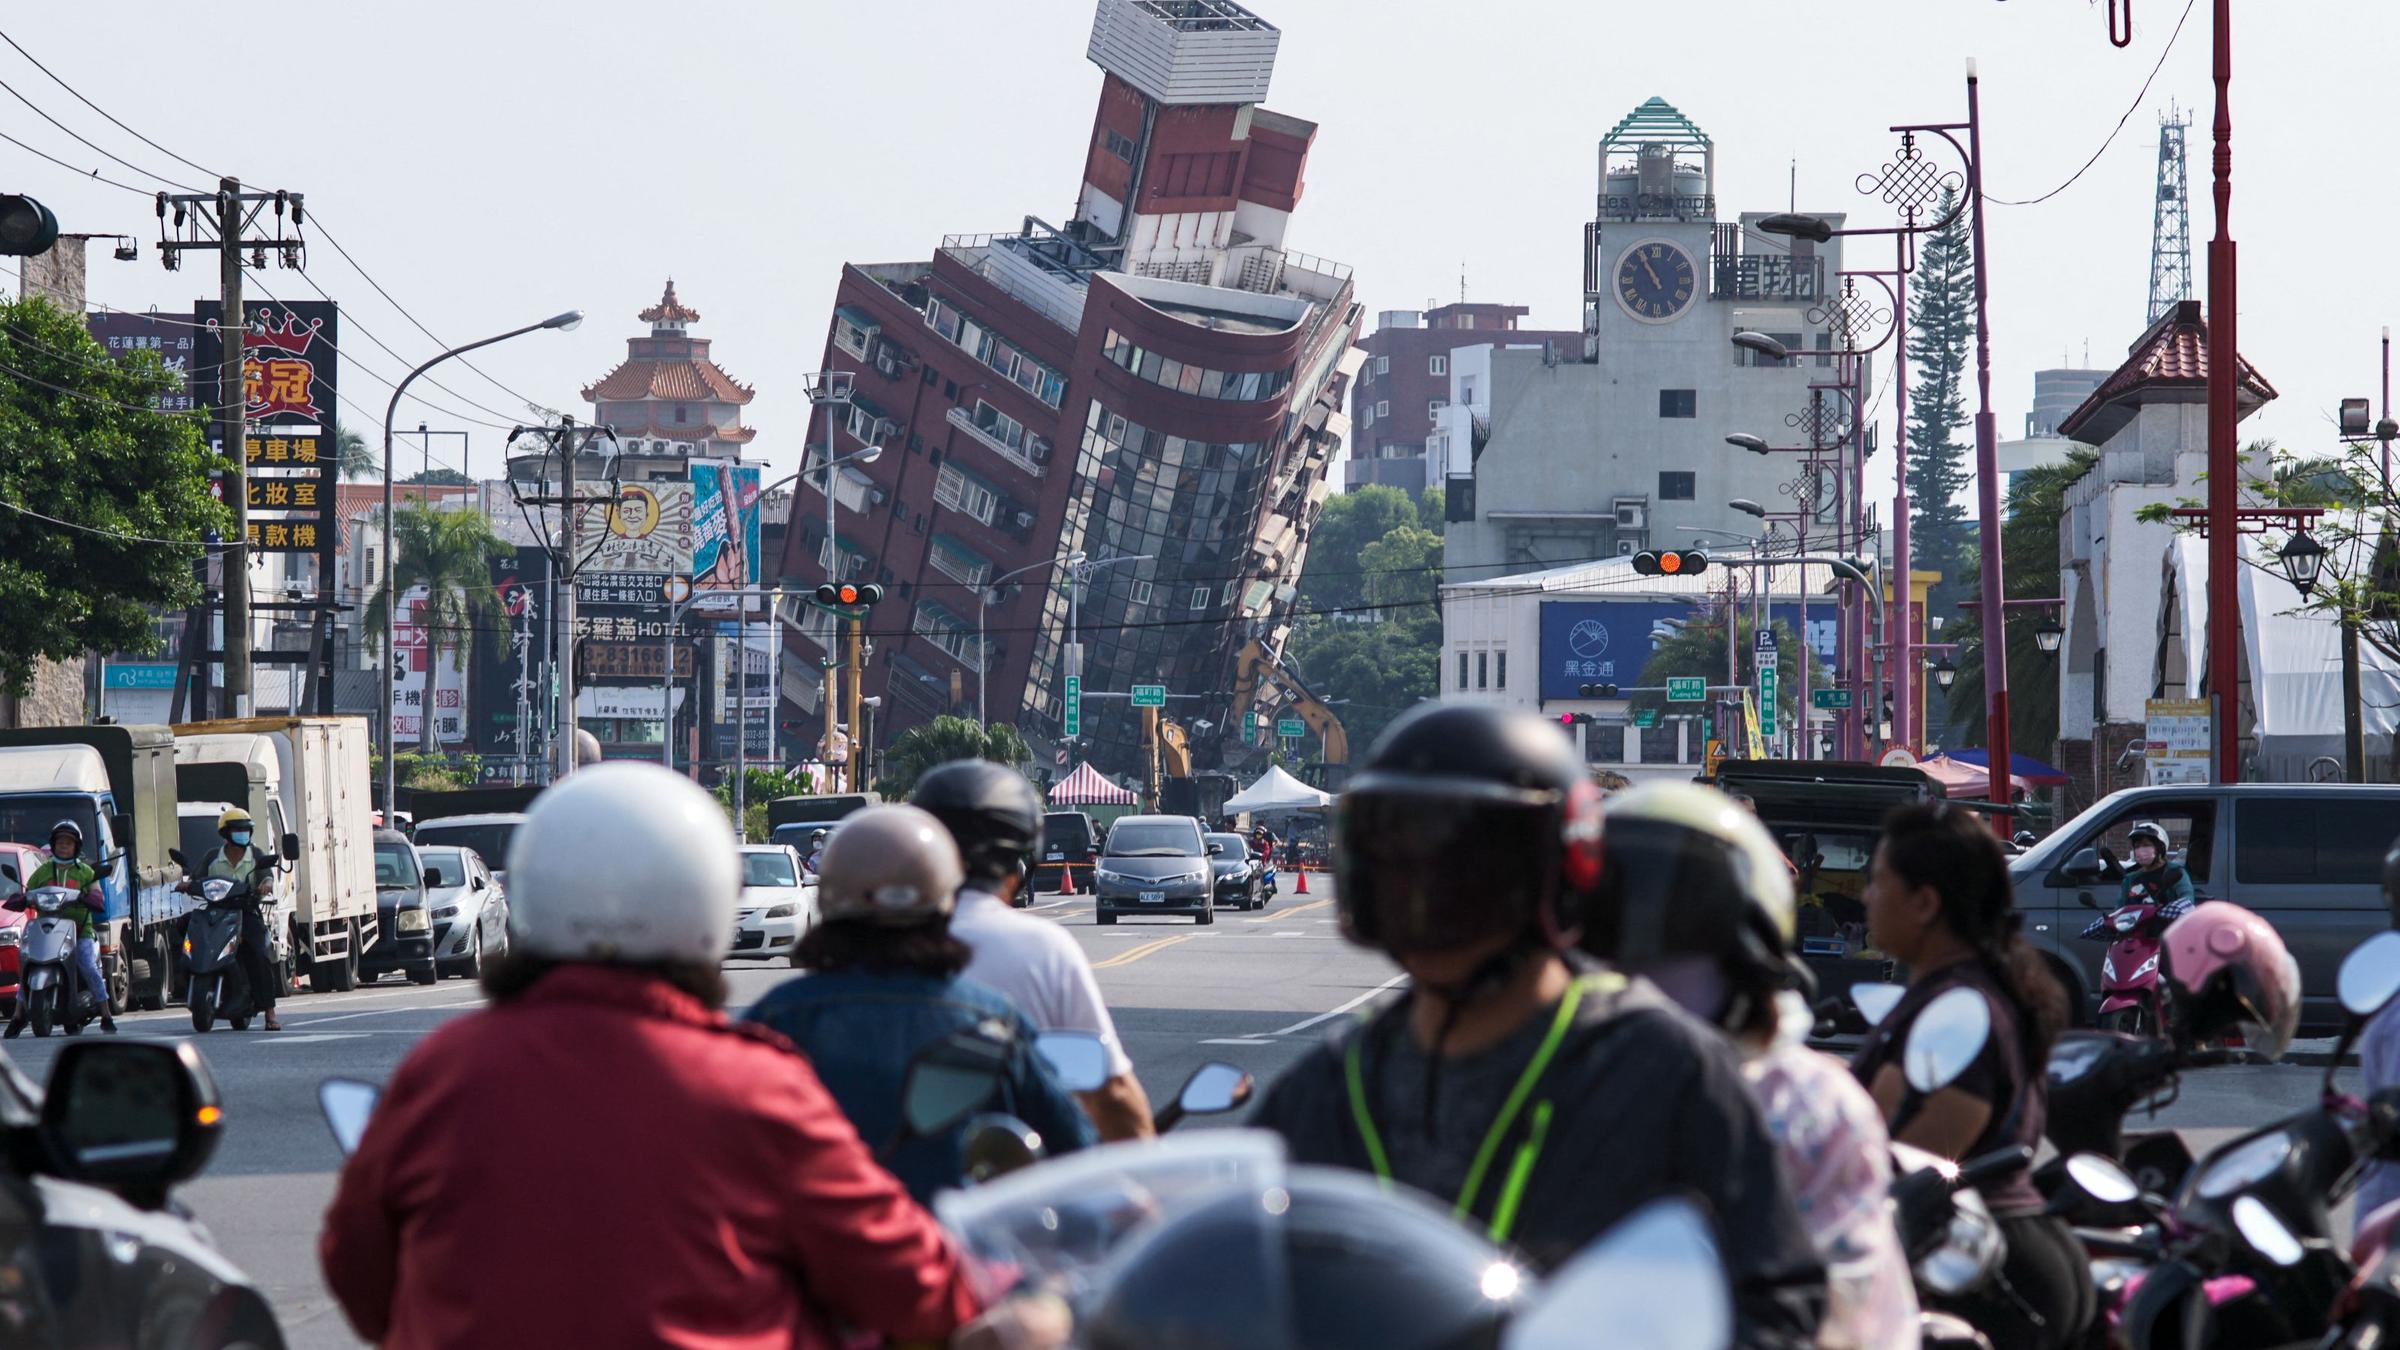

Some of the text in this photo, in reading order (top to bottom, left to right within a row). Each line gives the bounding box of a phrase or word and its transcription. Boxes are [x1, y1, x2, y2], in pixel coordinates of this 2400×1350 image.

[247, 482, 316, 506] 化妝室
[638, 622, 690, 636] HOTEL
[584, 645, 689, 661] 3-831662
[1564, 660, 1614, 677] 黑金通
[394, 690, 458, 706] 手機診
